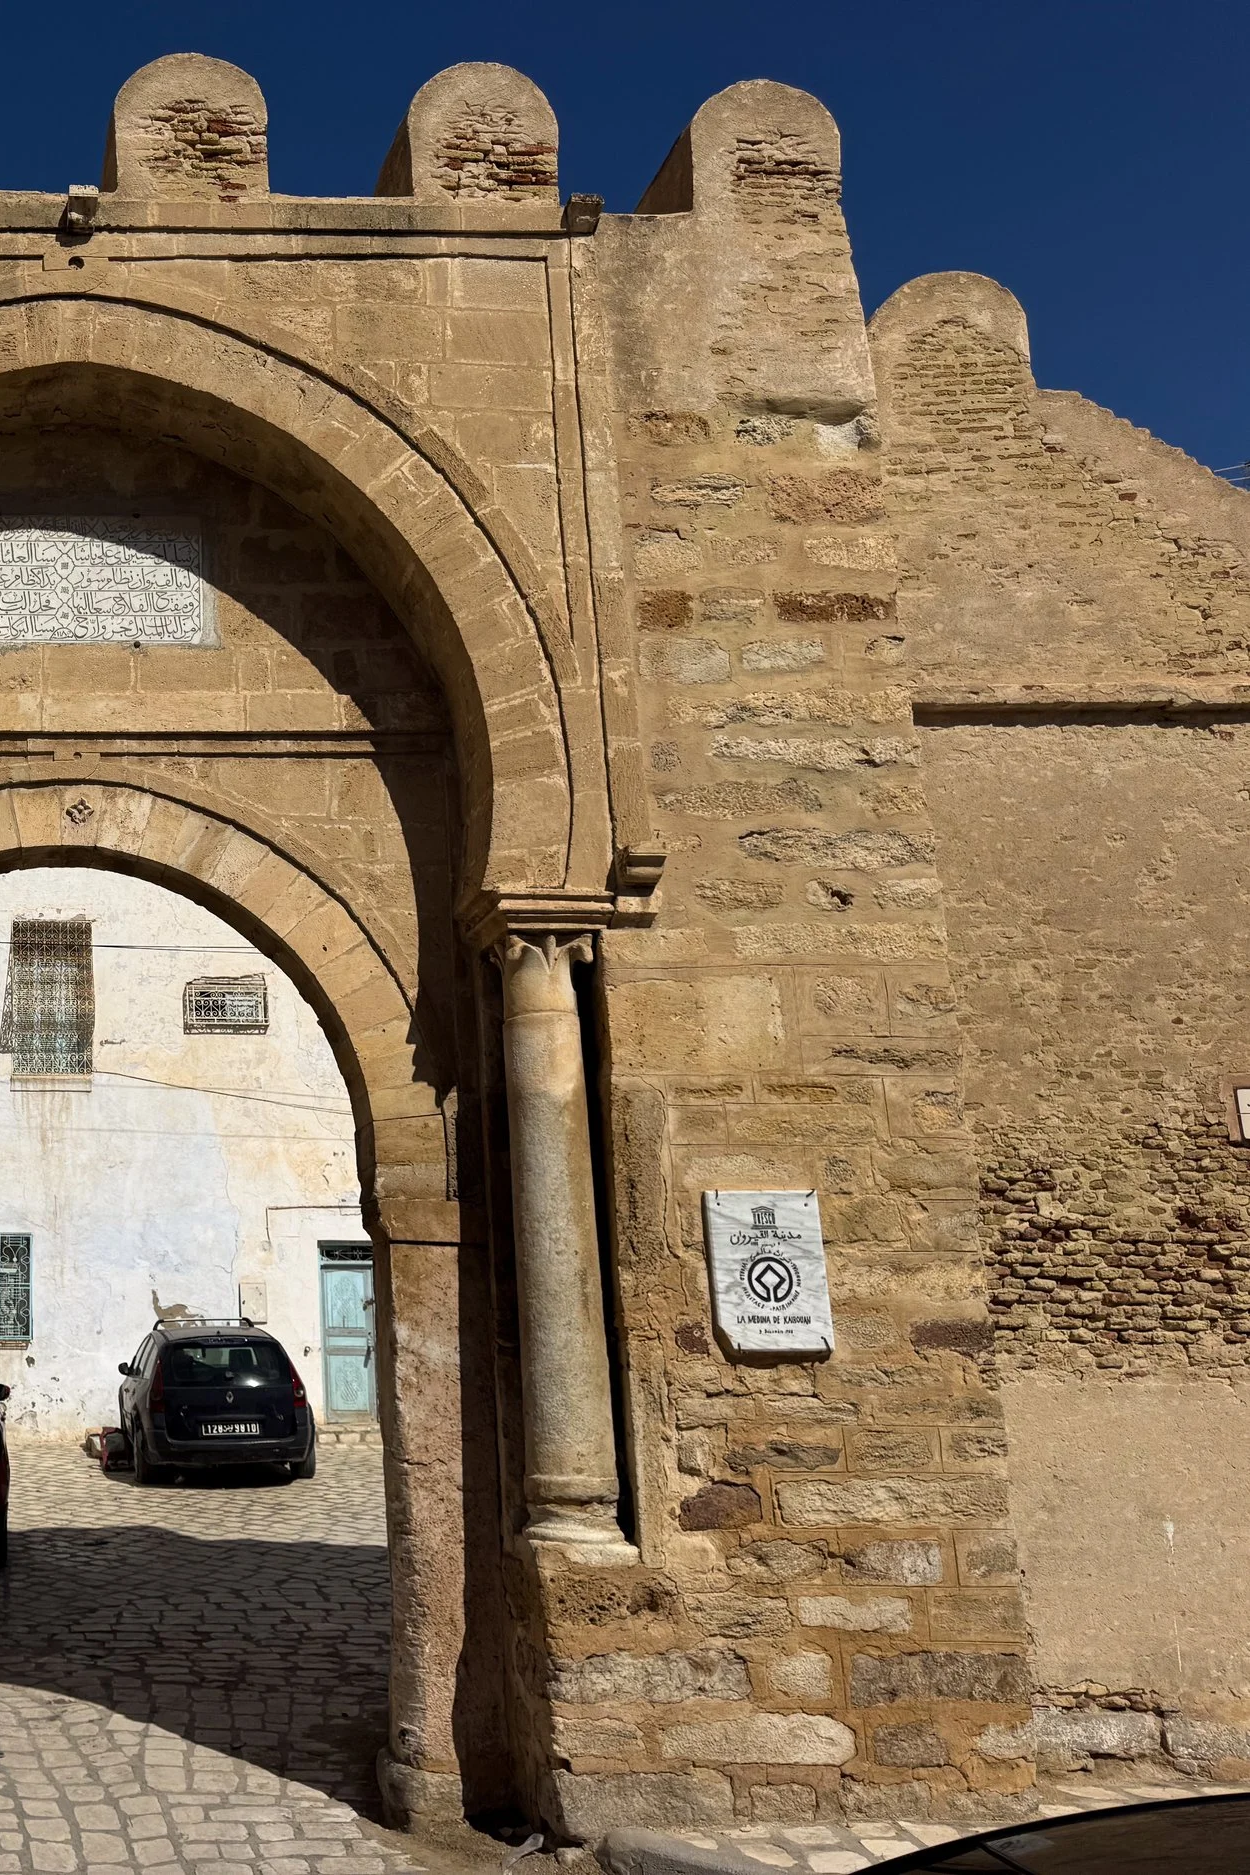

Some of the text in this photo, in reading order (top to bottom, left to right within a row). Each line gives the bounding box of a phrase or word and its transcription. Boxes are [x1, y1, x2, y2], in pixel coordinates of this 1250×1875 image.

[730, 1231, 768, 1245] القيروان
[771, 1231, 802, 1241] مدينة
[737, 1316, 811, 1325] LA MEDINA DE KAIROUAN
